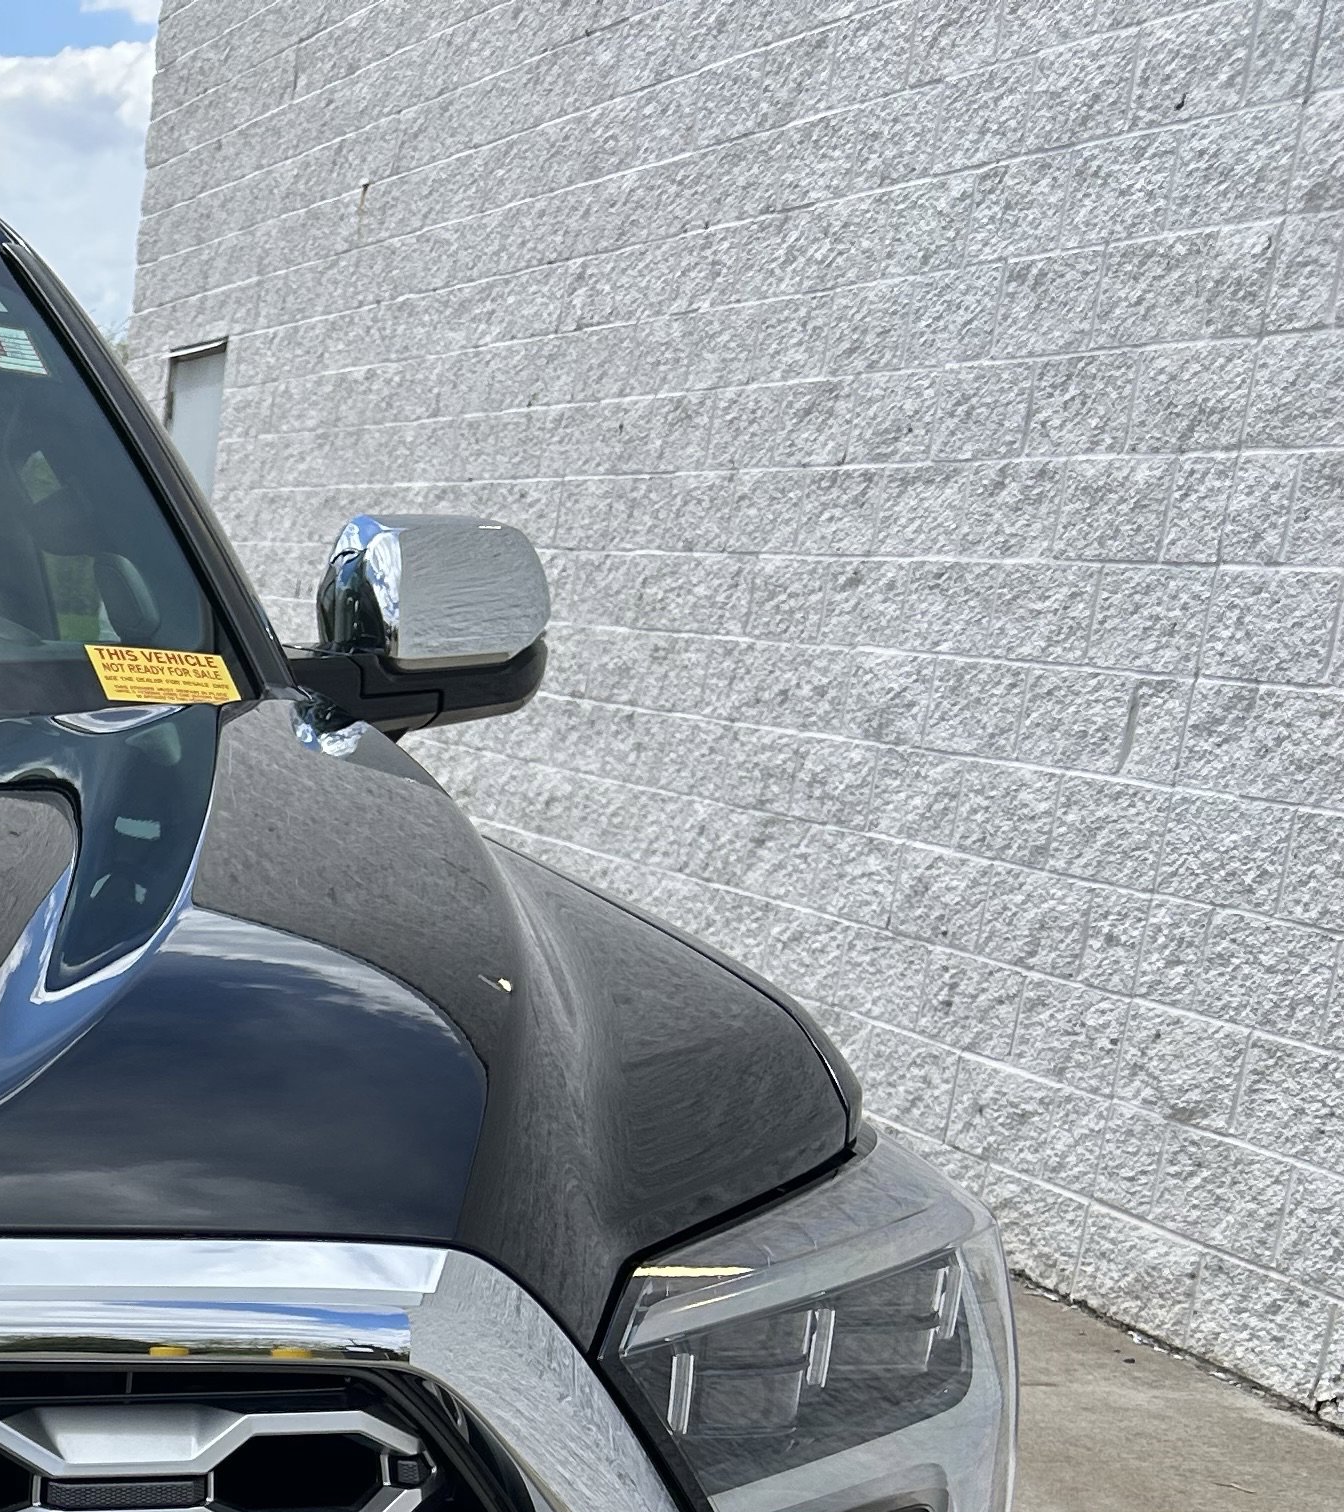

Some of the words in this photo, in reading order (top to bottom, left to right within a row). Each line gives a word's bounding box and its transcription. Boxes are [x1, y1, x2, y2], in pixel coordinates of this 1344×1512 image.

[94, 648, 138, 662] THIS
[140, 651, 219, 669] VEHICLE
[101, 662, 125, 672] NOT
[127, 664, 165, 676] READY
[168, 667, 192, 678] FOR
[192, 669, 223, 681] SALE
